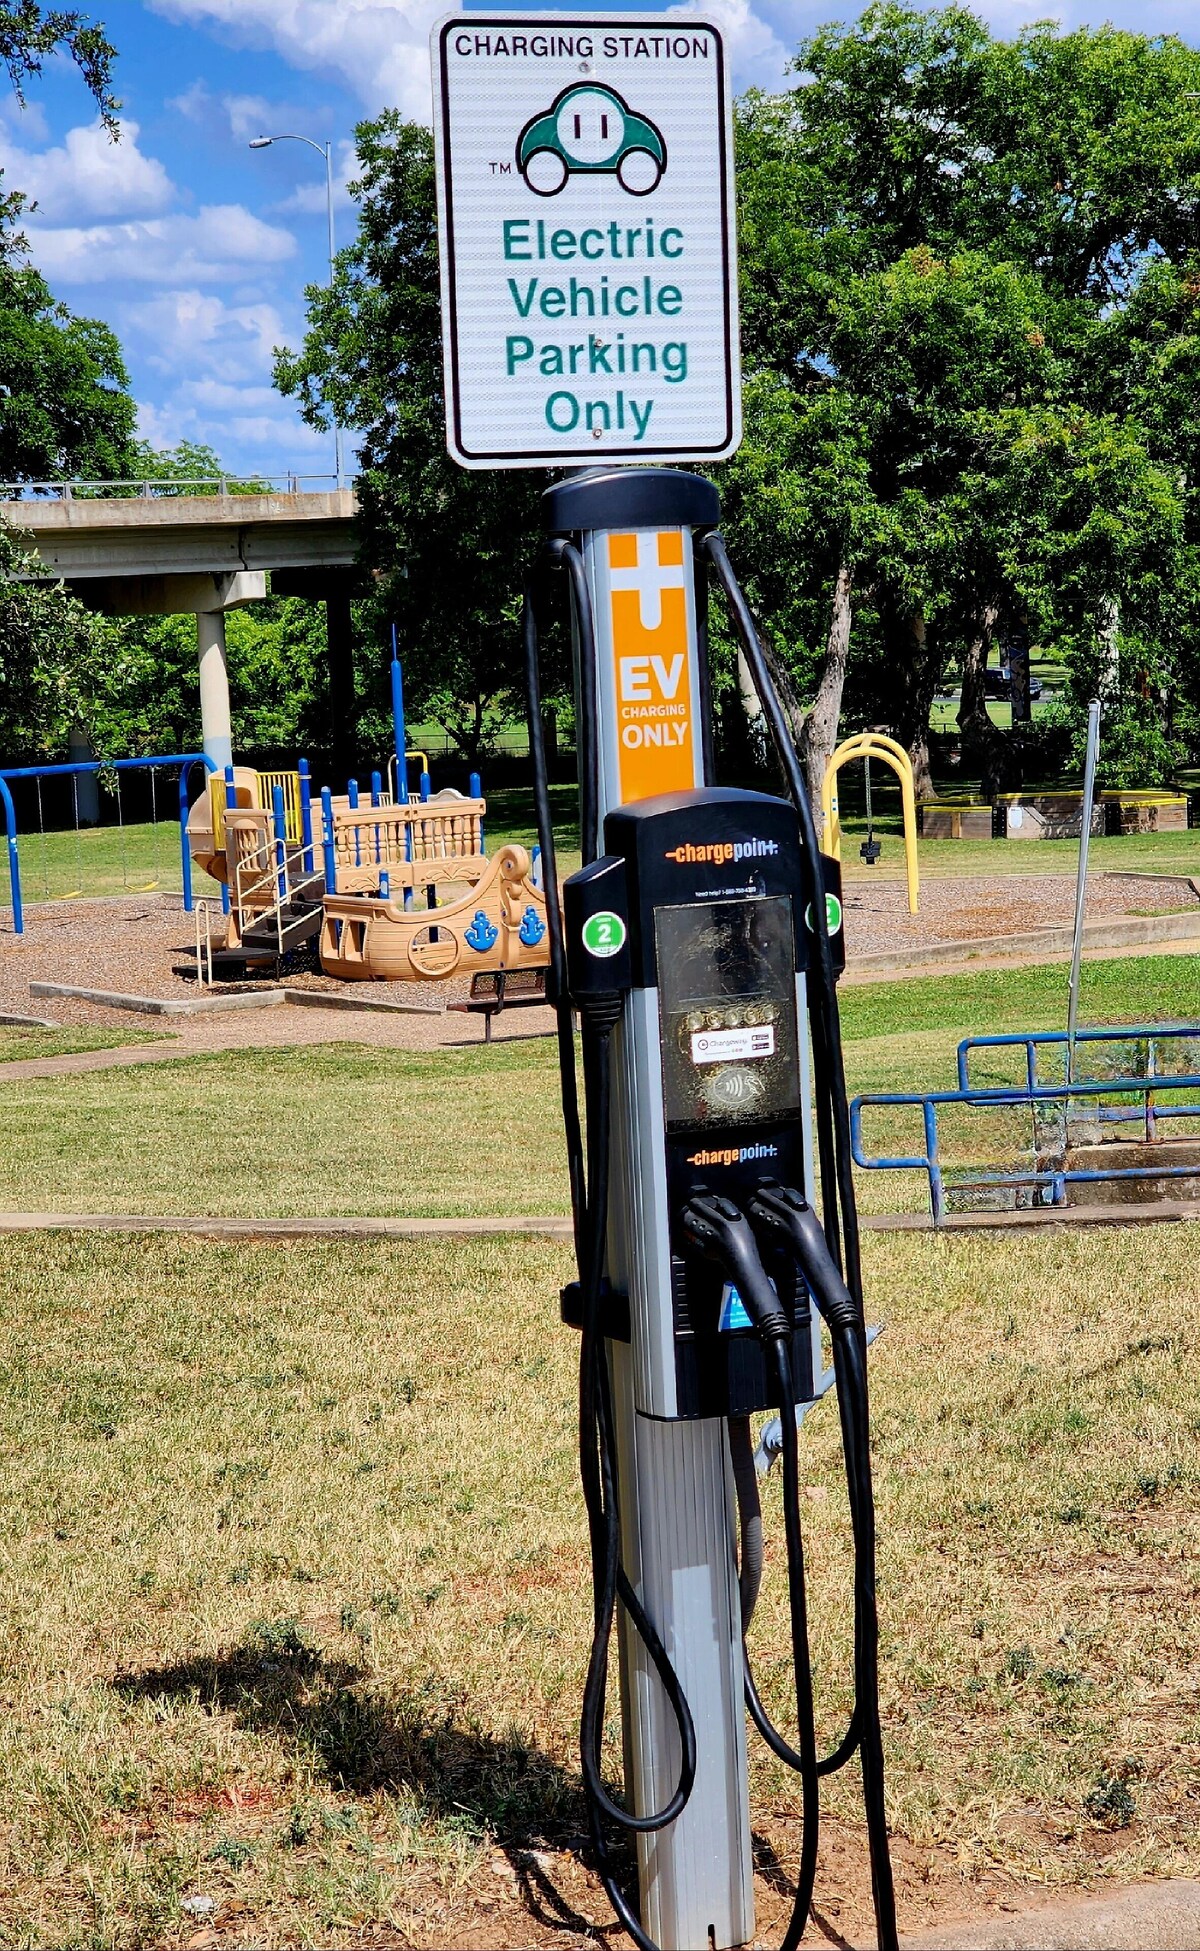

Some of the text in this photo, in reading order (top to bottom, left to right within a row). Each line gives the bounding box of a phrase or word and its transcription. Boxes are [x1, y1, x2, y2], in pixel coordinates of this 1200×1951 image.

[456, 35, 708, 59] CHARGING STATION
[489, 162, 511, 174] TM
[503, 218, 684, 260] Electric
[507, 277, 682, 317] Vehicle
[506, 334, 688, 382] Parking
[545, 391, 654, 440] Only
[620, 654, 684, 701] EV
[621, 703, 686, 719] CHARGING
[622, 721, 688, 749] ONLY
[598, 923, 611, 943] 2
